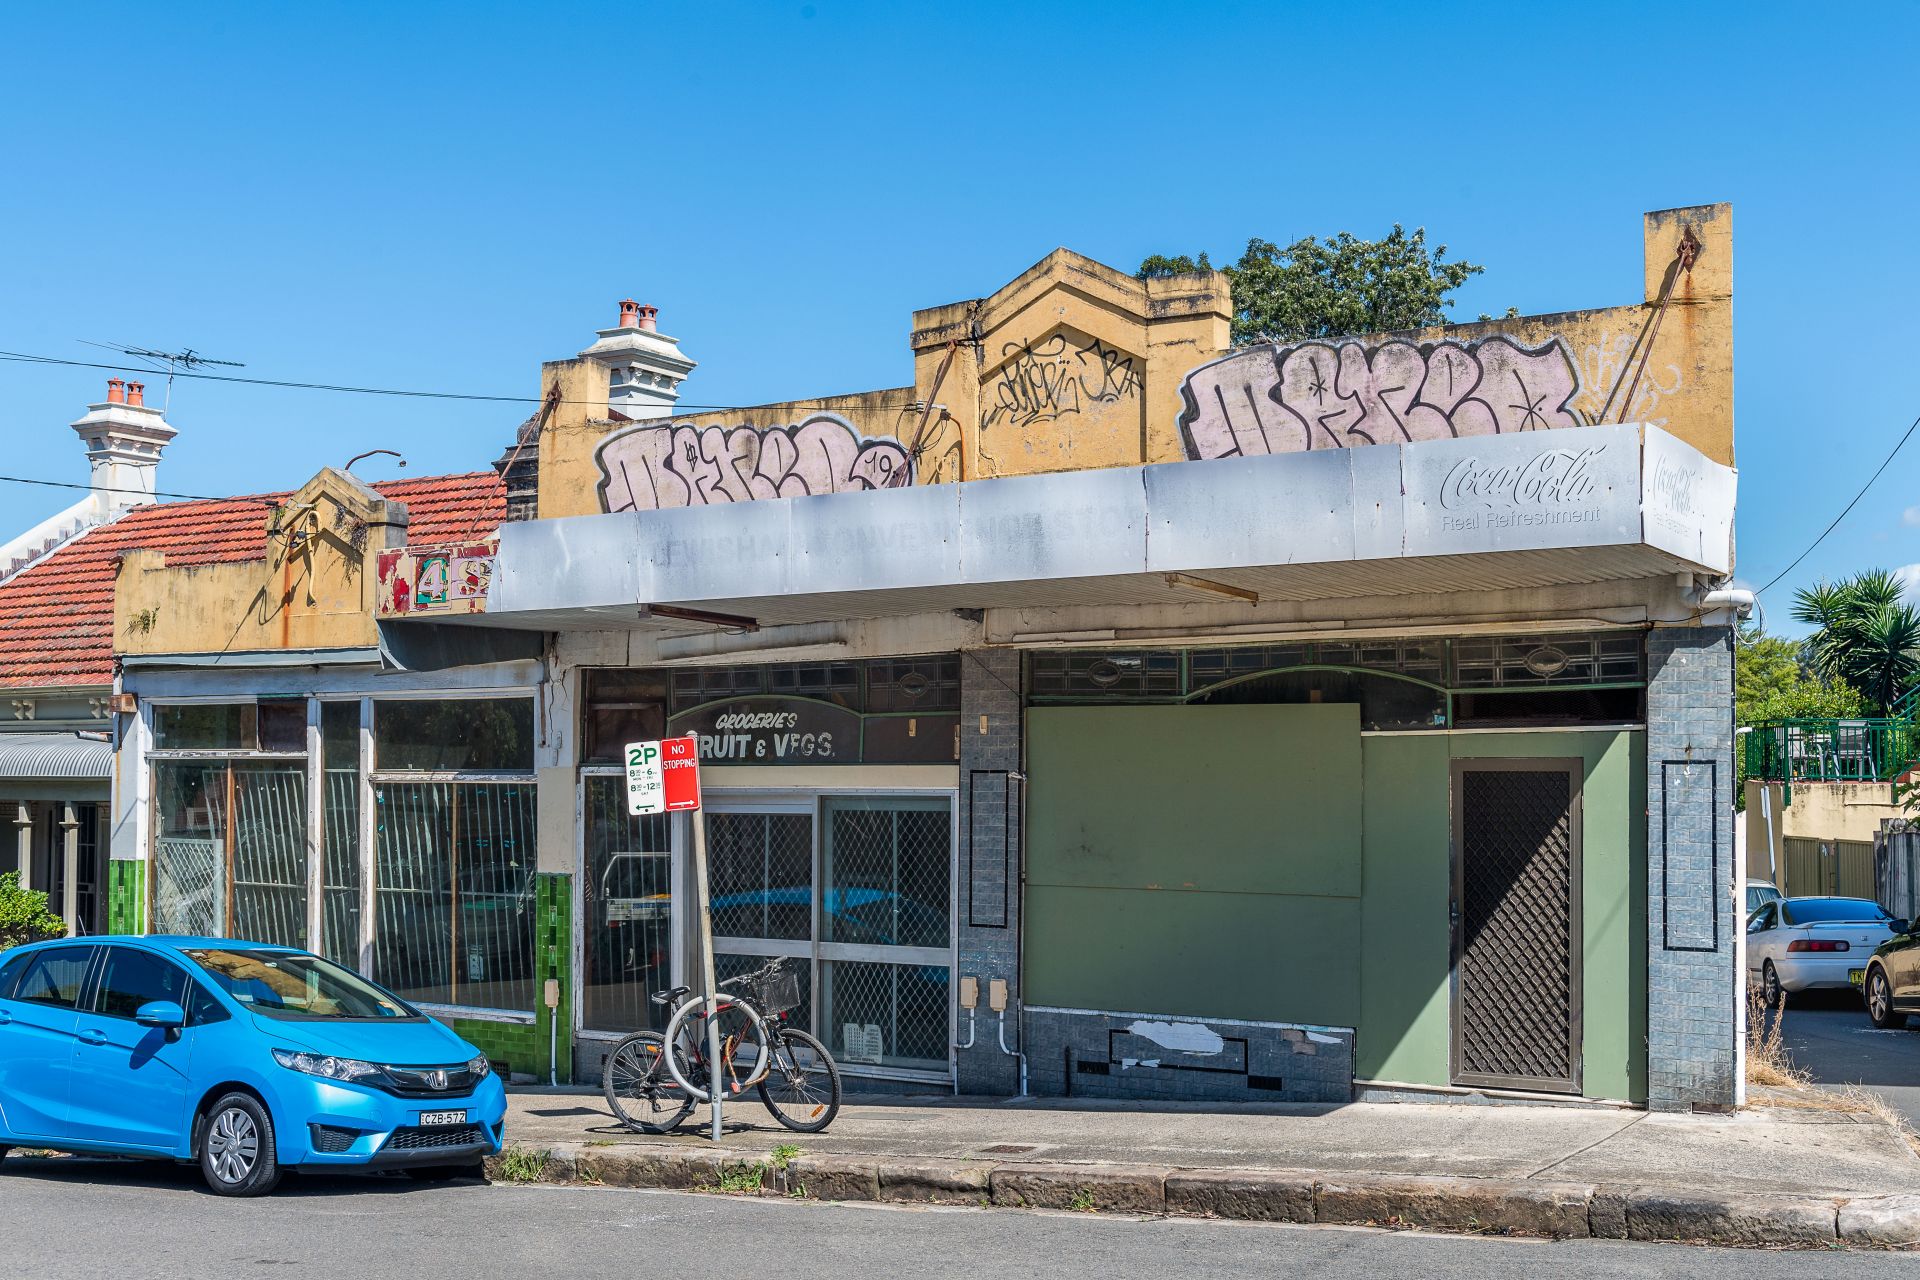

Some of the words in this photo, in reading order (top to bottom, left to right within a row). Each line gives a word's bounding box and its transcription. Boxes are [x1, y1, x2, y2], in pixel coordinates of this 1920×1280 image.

[1441, 511, 1480, 532] Real
[1486, 505, 1602, 528] Refreshment
[671, 745, 685, 755] NO
[698, 734, 752, 759] RUIT
[755, 739, 766, 758] &
[629, 748, 657, 766] 2P
[663, 758, 696, 770] STOPPING
